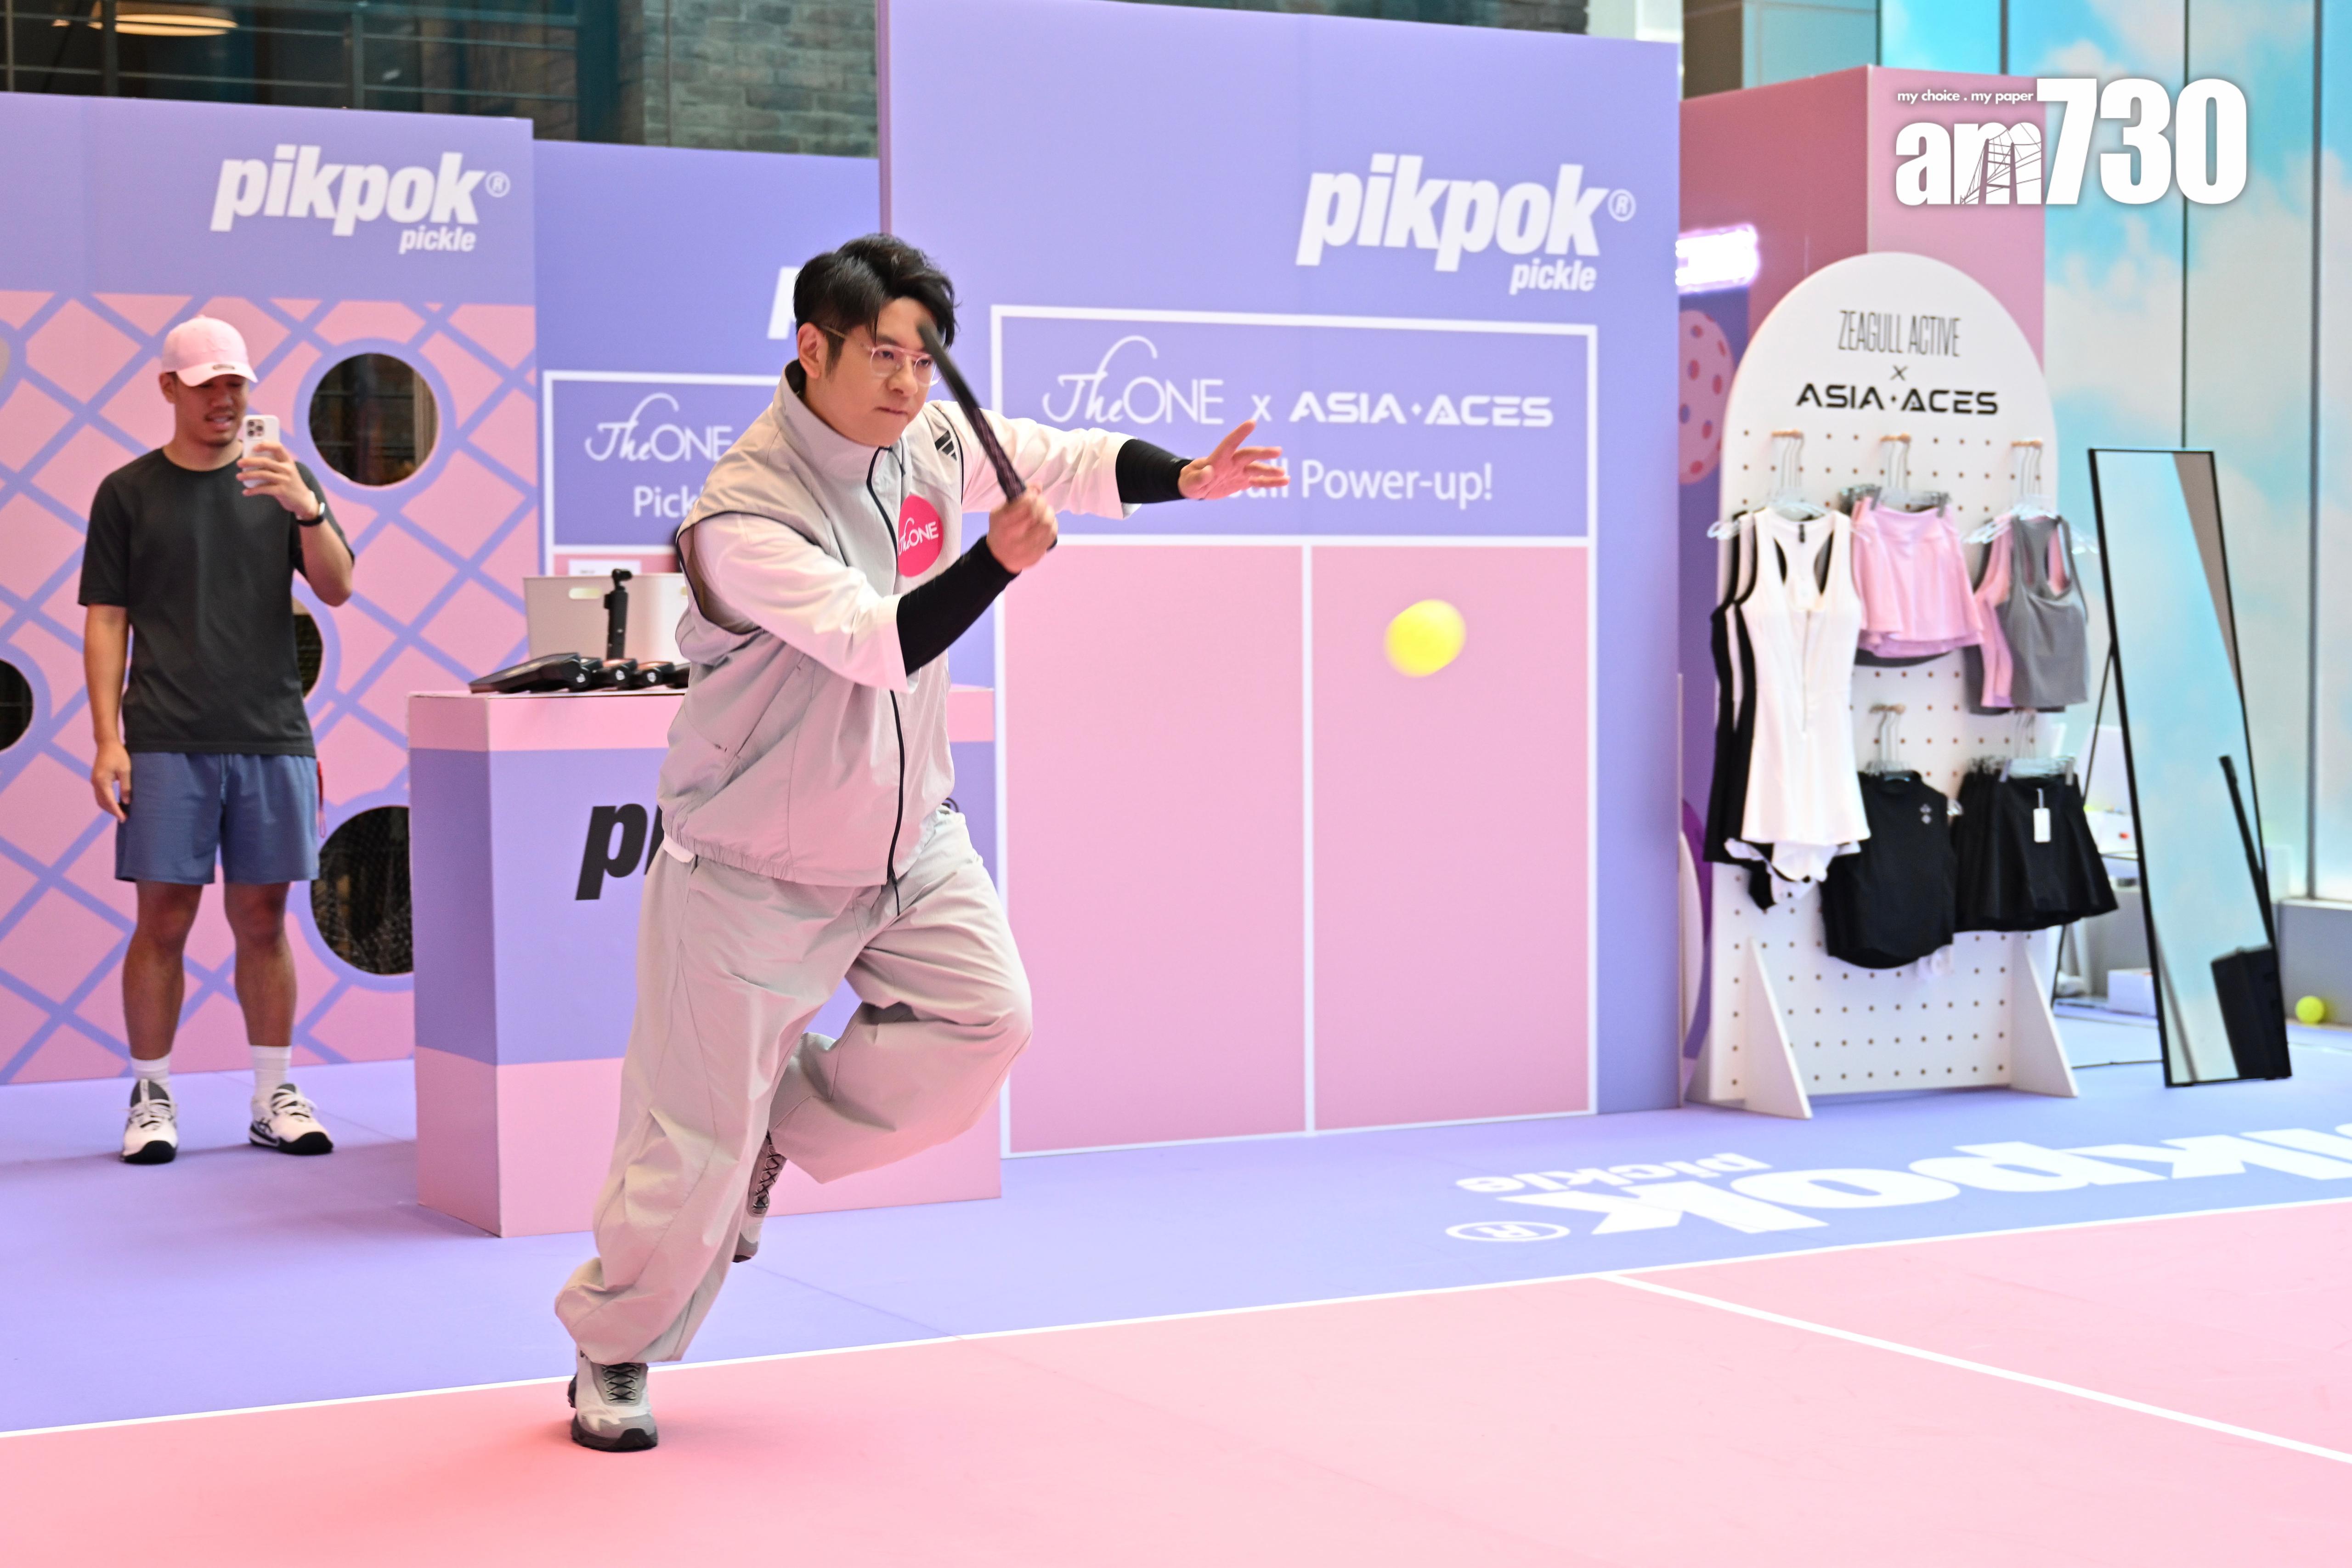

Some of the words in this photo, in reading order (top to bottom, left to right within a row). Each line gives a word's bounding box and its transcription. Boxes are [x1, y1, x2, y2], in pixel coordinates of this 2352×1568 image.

[399, 226, 476, 254] pickle
[1509, 258, 1597, 295] pickle
[1838, 310, 1903, 353] ZEAGULL
[1907, 315, 1961, 357] ACTIVE
[633, 485, 704, 518] Pick
[1302, 460, 1492, 510] Power-up!
